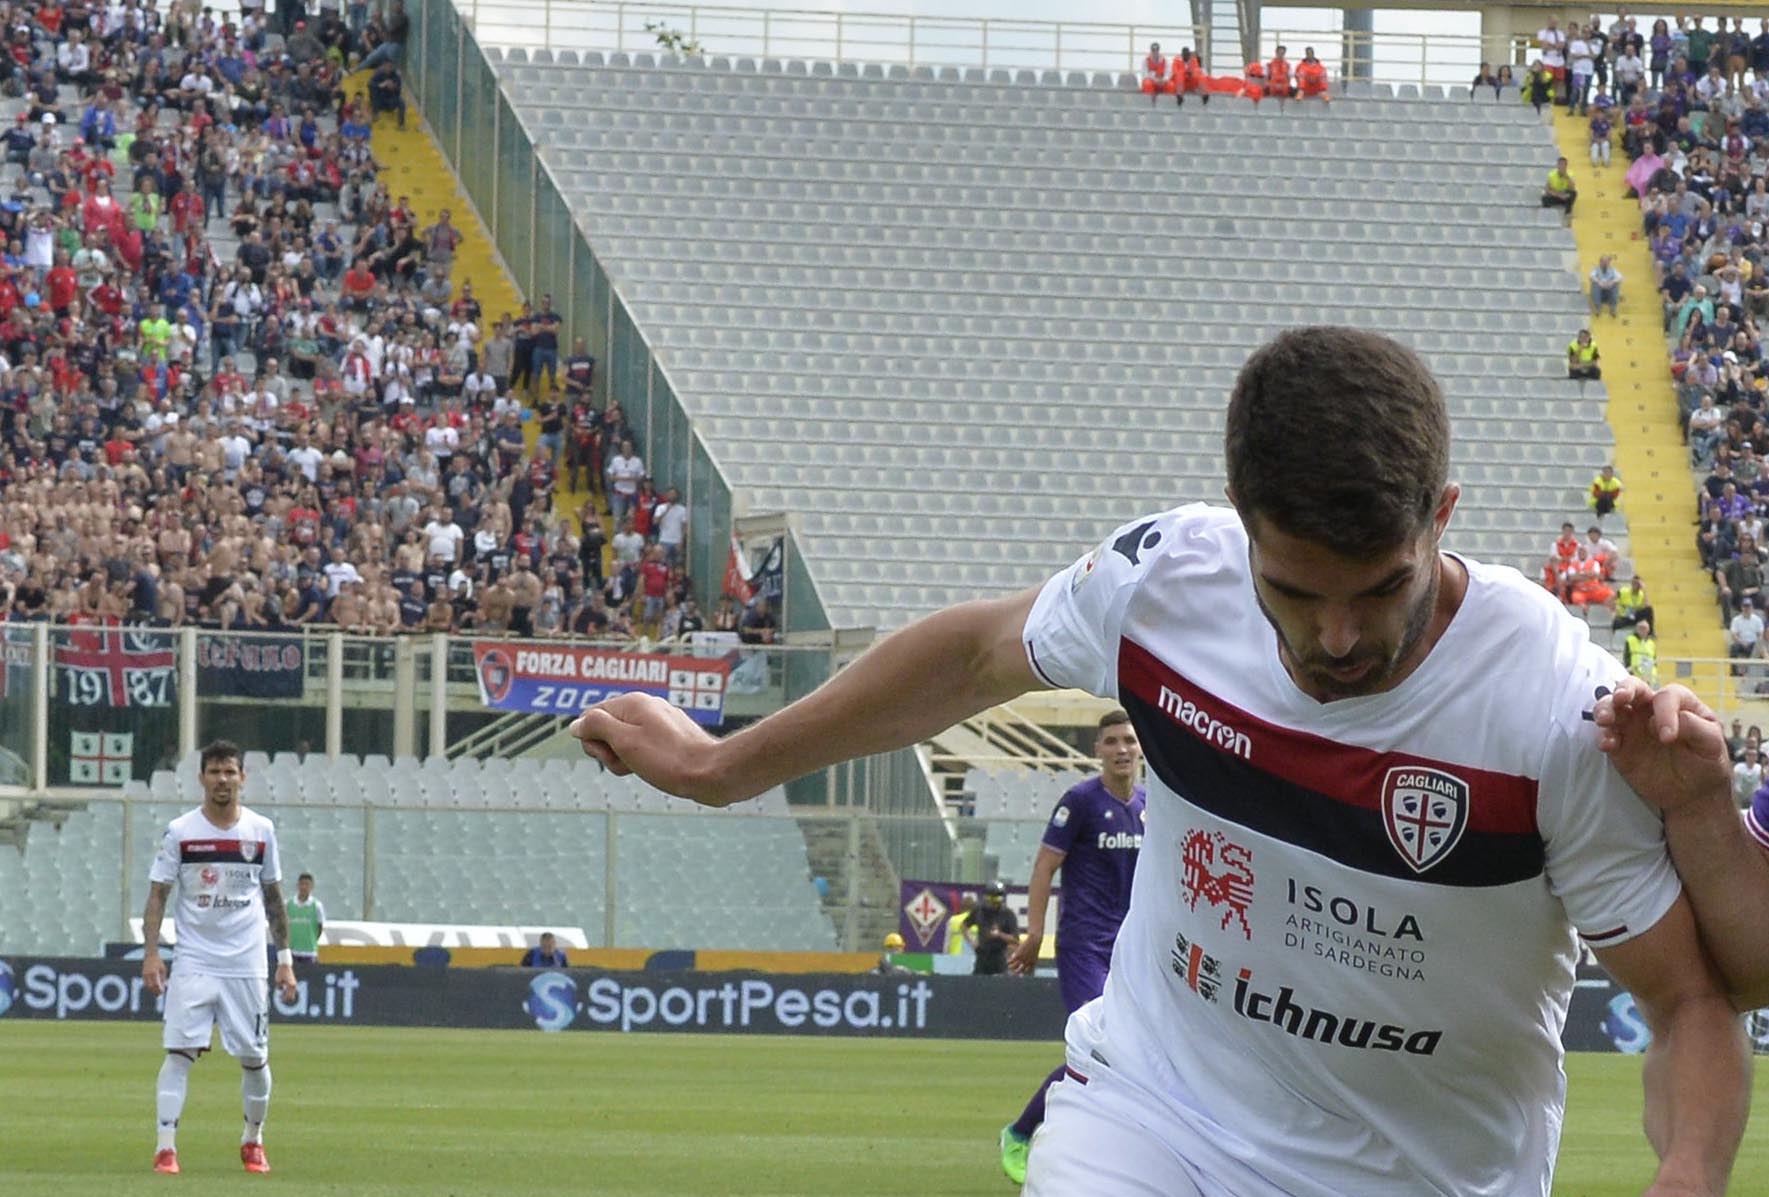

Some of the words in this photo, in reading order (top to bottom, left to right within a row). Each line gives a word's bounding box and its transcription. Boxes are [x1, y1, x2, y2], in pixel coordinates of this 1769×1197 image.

[515, 650, 577, 675] FORZA
[581, 656, 668, 682] CAGLIARI
[1158, 685, 1252, 760] macron
[1396, 774, 1457, 800] CAGLIARI
[1288, 878, 1424, 942] ISOLA
[1285, 932, 1305, 950] DI
[1314, 942, 1425, 982] SARDEGNA
[1286, 913, 1426, 964] ARTIGIANATO
[588, 978, 933, 1032] SportPesa.it
[1234, 967, 1443, 1056] ichnusa
